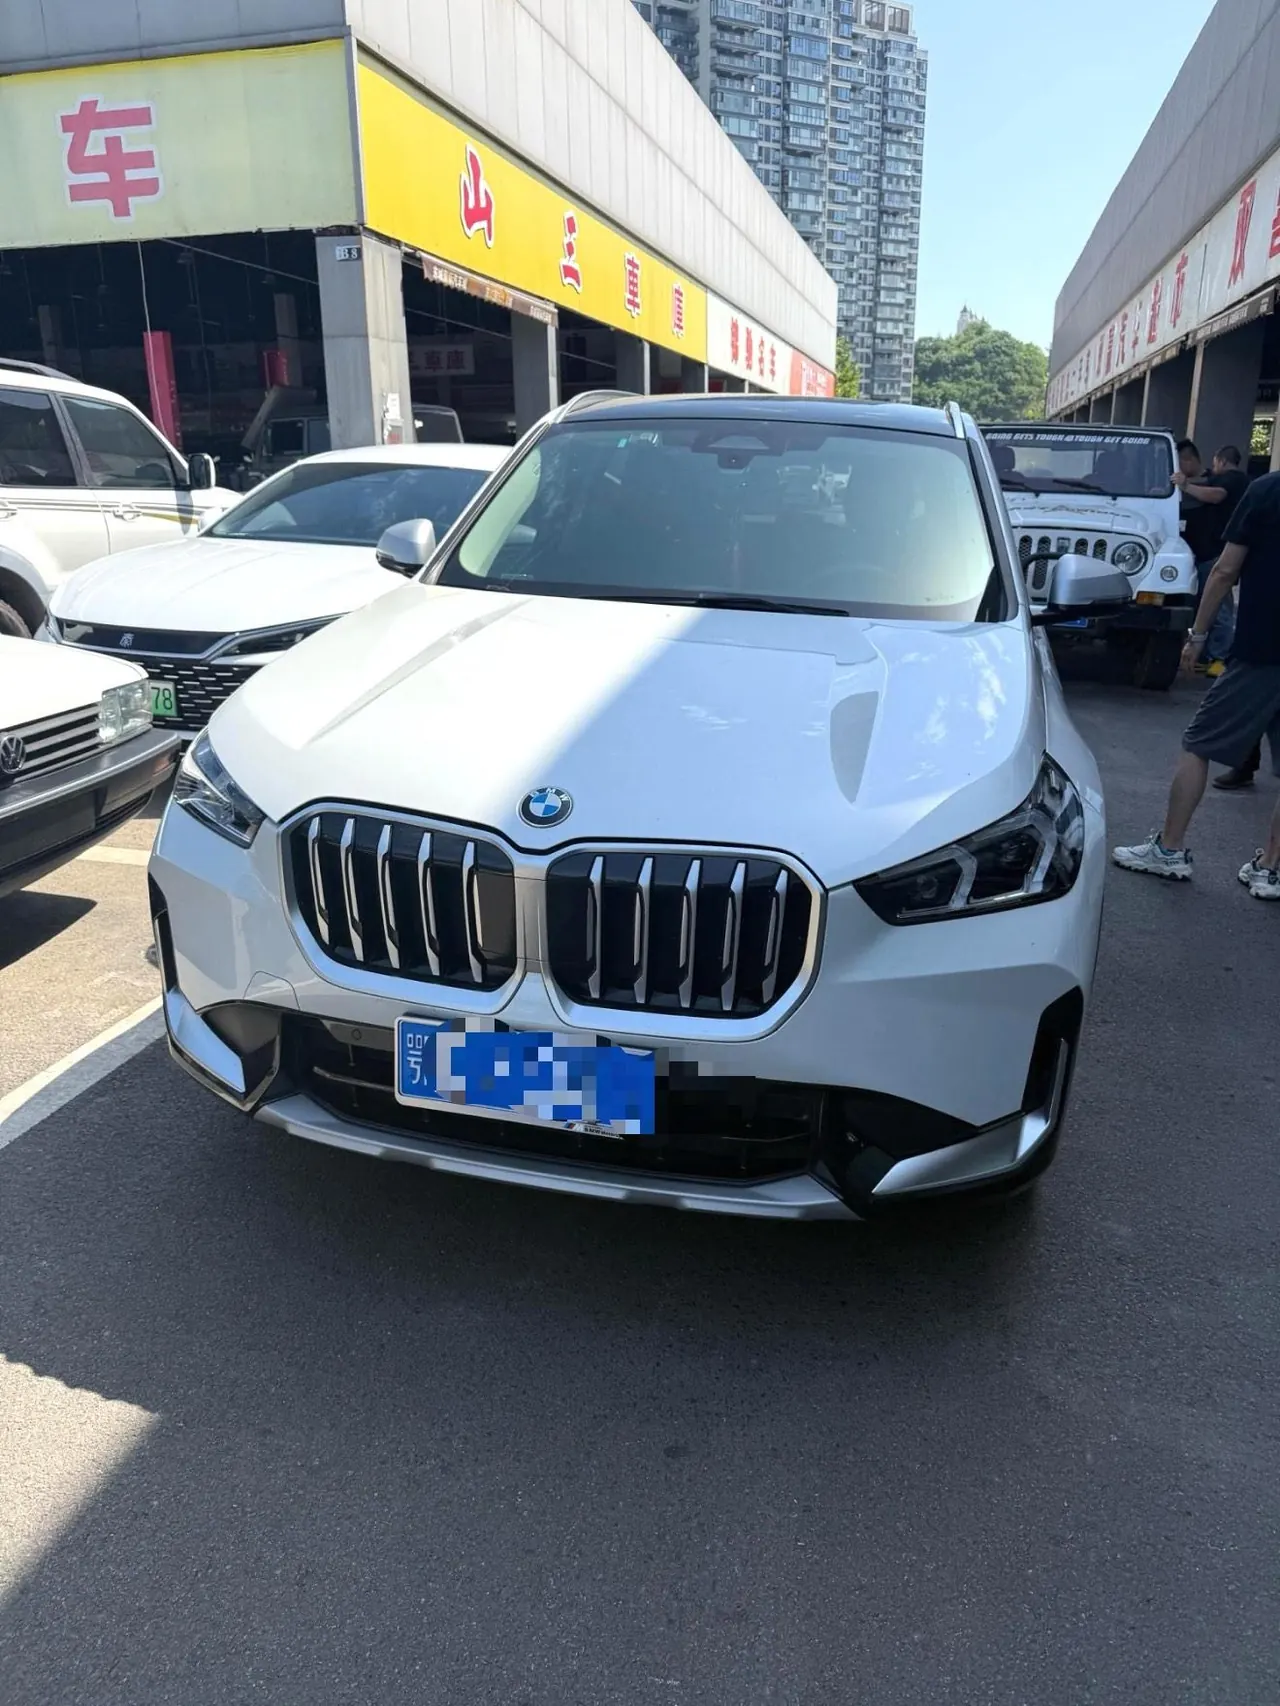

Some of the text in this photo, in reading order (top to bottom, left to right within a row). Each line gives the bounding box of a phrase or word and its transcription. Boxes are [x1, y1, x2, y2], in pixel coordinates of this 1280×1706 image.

[58, 97, 160, 219] 车
[1074, 435, 1102, 443] TOUGH
[151, 687, 173, 711] 78
